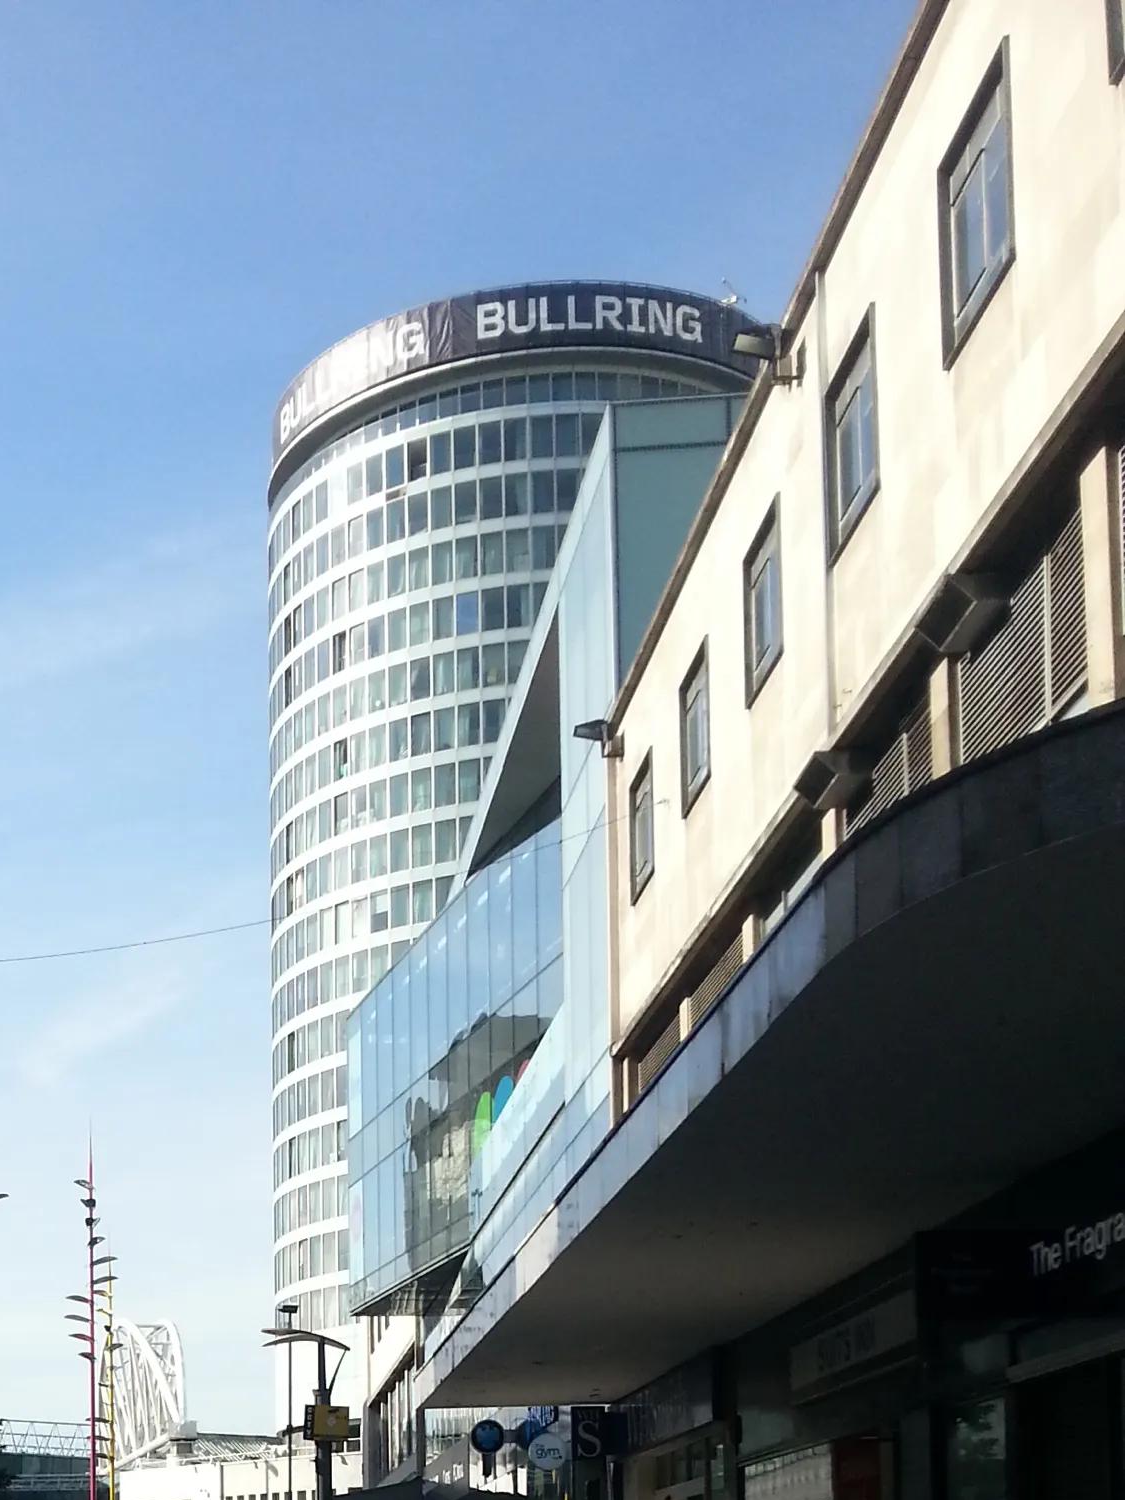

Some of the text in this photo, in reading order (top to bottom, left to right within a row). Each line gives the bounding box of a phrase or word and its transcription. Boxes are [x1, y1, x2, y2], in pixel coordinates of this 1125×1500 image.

[476, 295, 703, 343] BULLRING
[280, 322, 425, 444] BULLNG
[1029, 1241, 1062, 1277] The
[536, 1448, 560, 1459] gym
